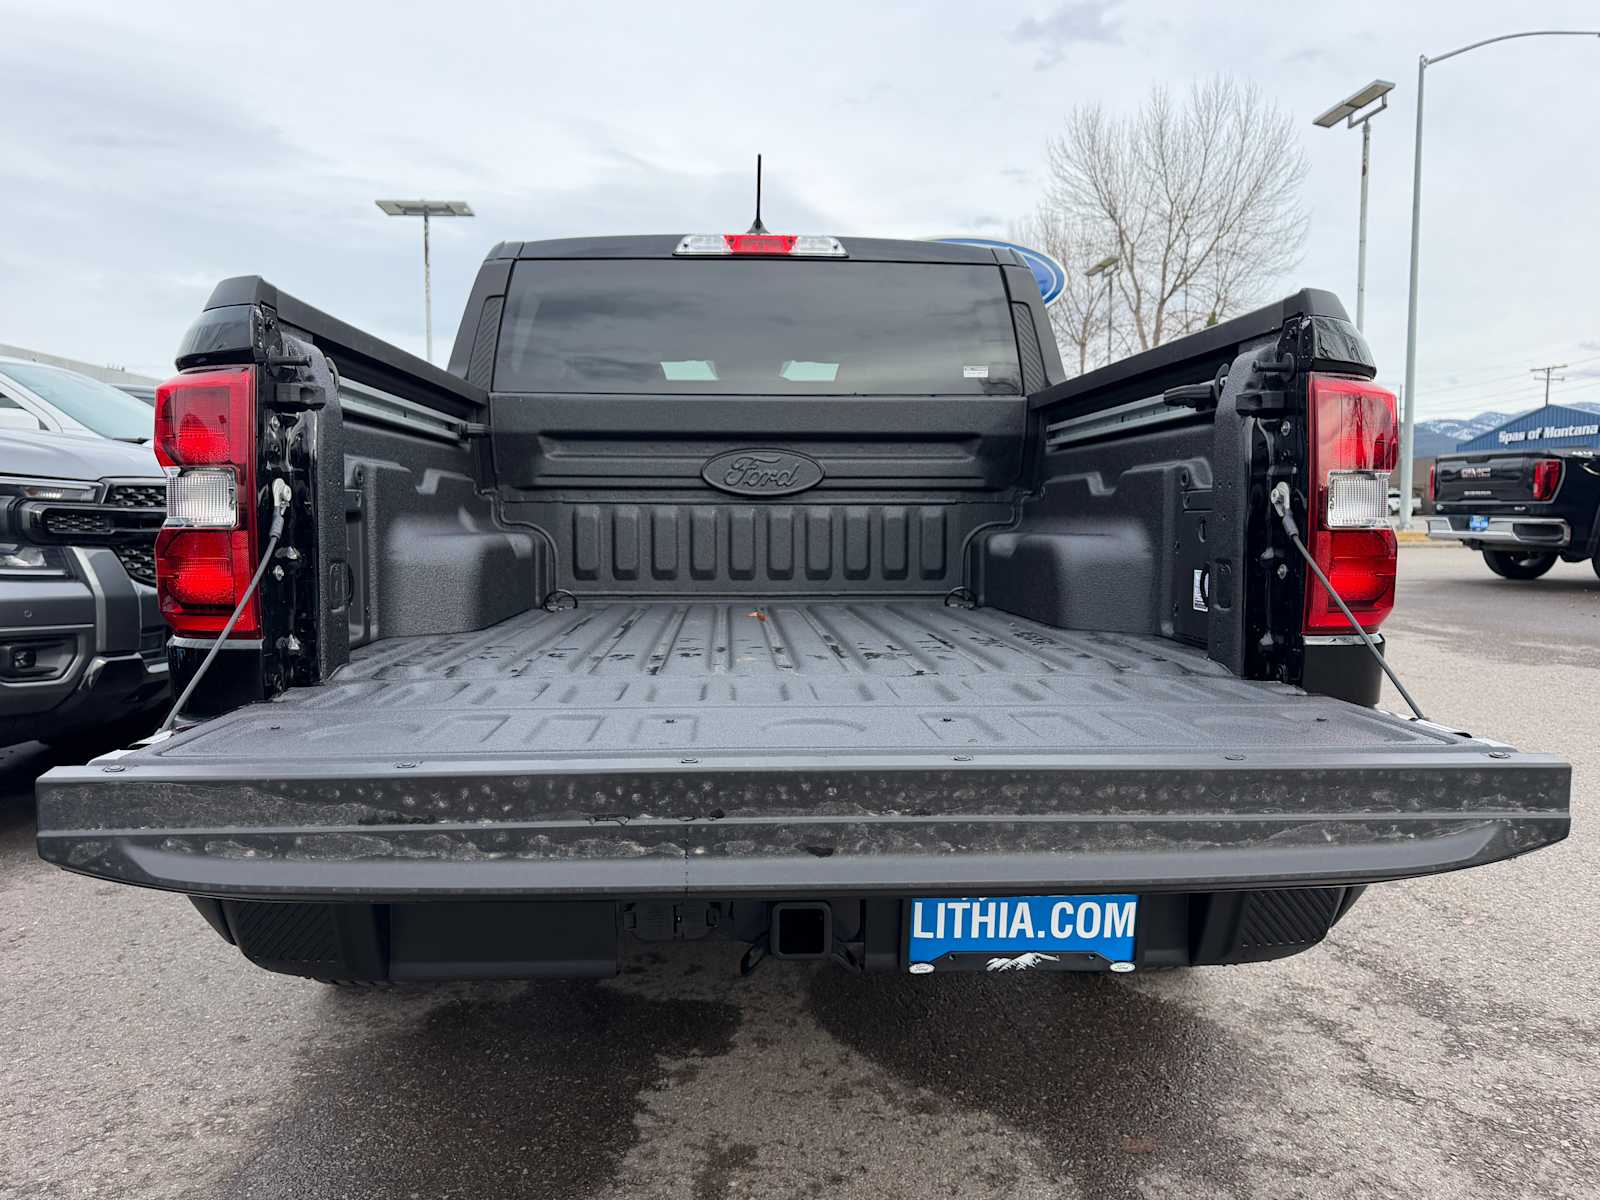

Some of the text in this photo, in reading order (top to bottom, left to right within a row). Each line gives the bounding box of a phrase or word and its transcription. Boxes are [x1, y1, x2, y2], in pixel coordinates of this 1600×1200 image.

[1498, 424, 1598, 444] Spas of Montana
[724, 456, 800, 487] Ford
[912, 901, 1137, 939] LITHIA.COM
